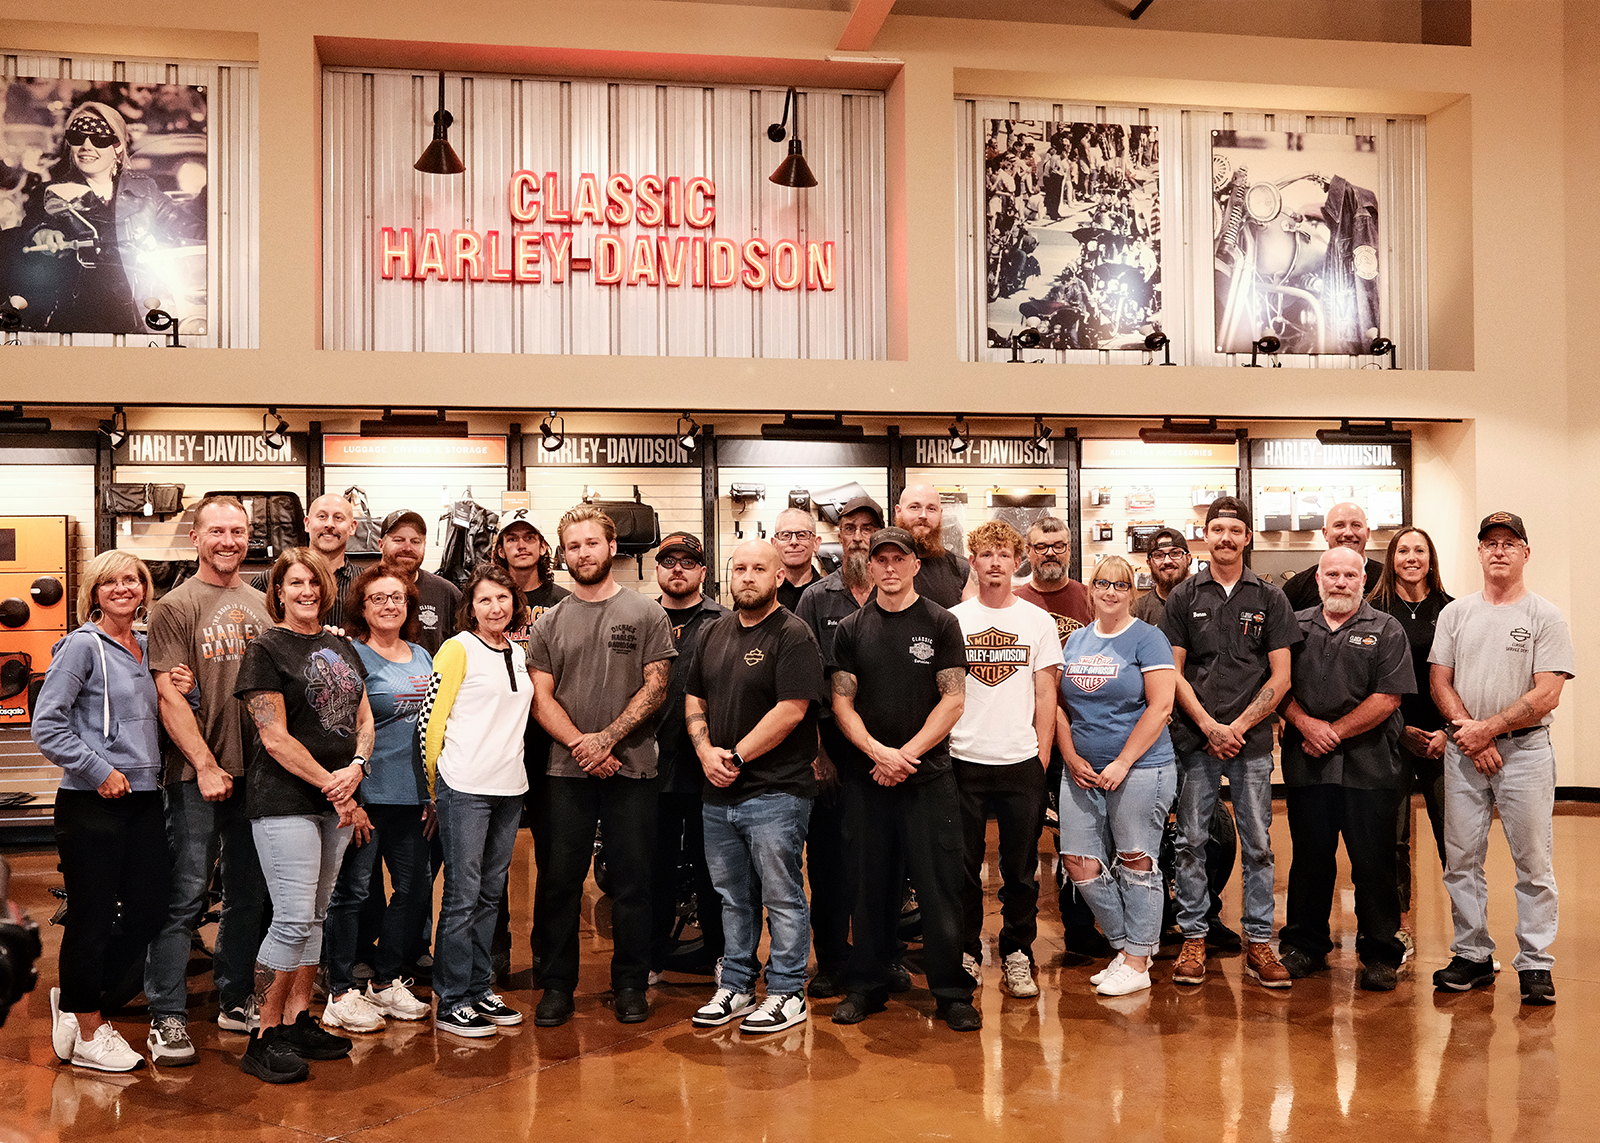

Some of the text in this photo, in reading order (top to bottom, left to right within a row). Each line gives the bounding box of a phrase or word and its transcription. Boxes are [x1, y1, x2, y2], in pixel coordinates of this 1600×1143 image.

[510, 169, 716, 228] CLASSIC
[381, 226, 836, 291] HARLEY-DAVIDSON
[445, 446, 488, 454] STORAGE
[1109, 449, 1127, 457] ADD
[1157, 449, 1213, 457] ACCESSORIES
[202, 623, 263, 643] HARLEY
[974, 632, 1011, 646] MOTOR
[201, 638, 247, 659] DAVID
[973, 665, 1010, 683] CYCLES
[1076, 676, 1102, 689] CYCLES
